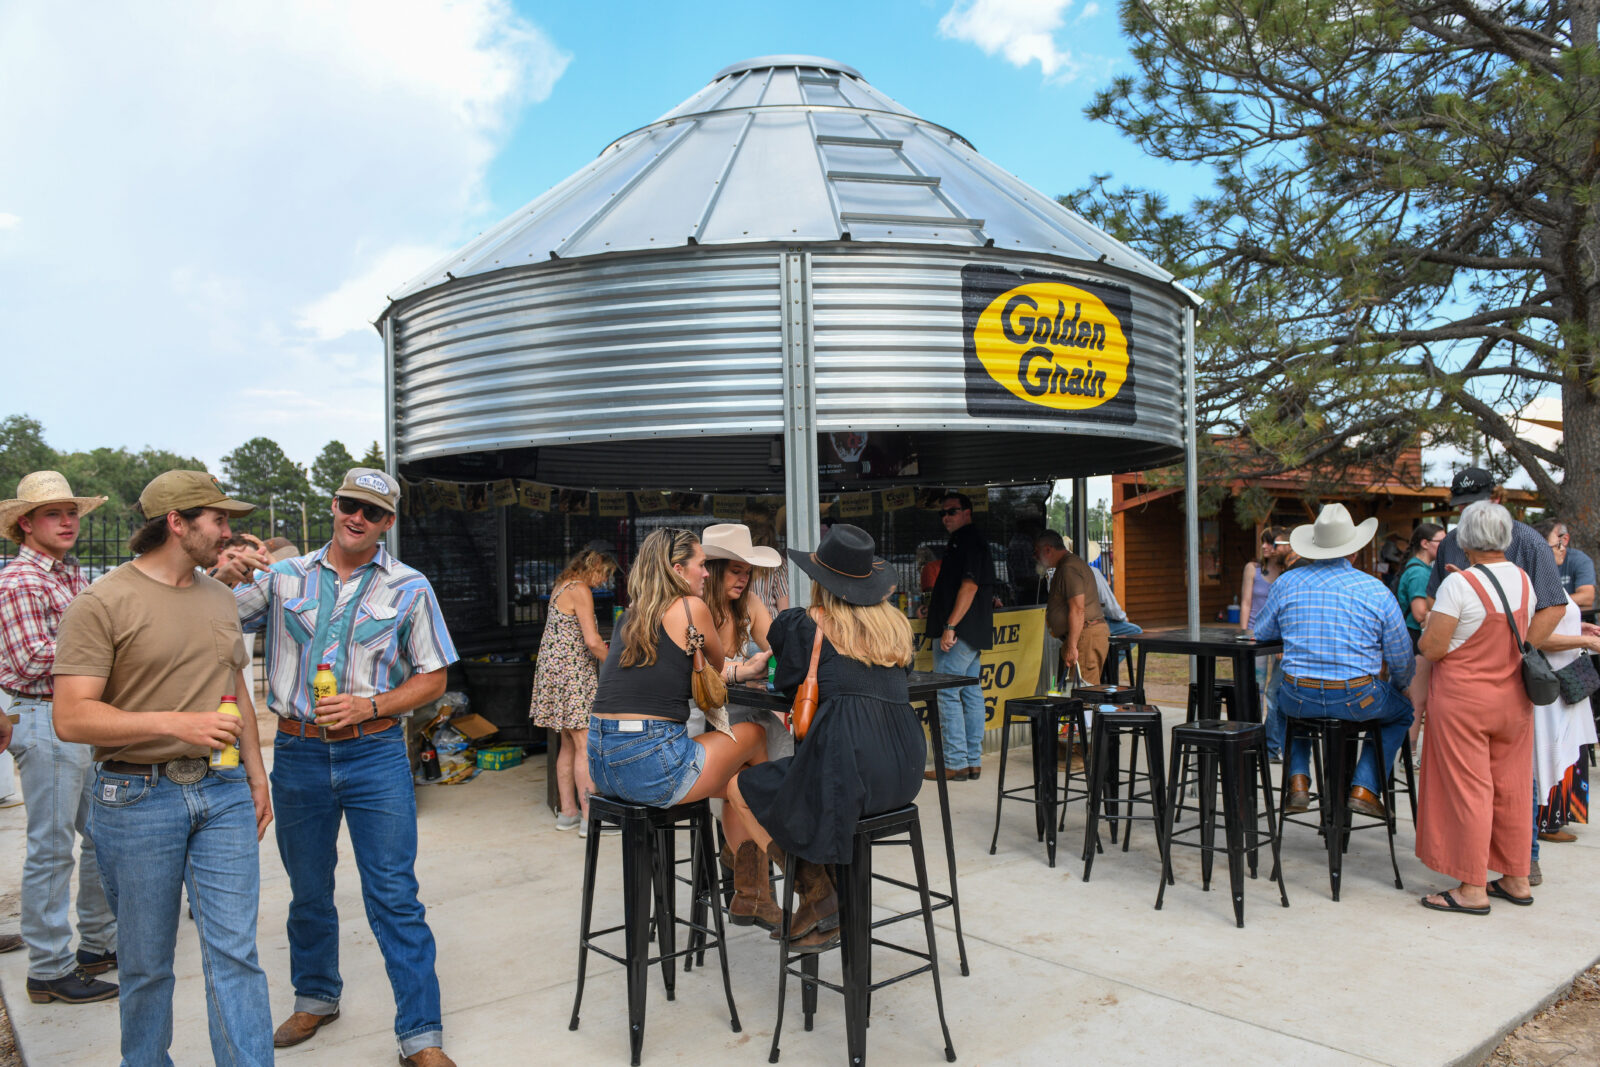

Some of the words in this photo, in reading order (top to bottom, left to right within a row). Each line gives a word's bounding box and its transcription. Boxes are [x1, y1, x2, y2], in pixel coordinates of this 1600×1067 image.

[1001, 294, 1106, 351] Golden
[1017, 346, 1107, 398] Grain
[992, 624, 1020, 646] ME
[980, 661, 1015, 690] EO
